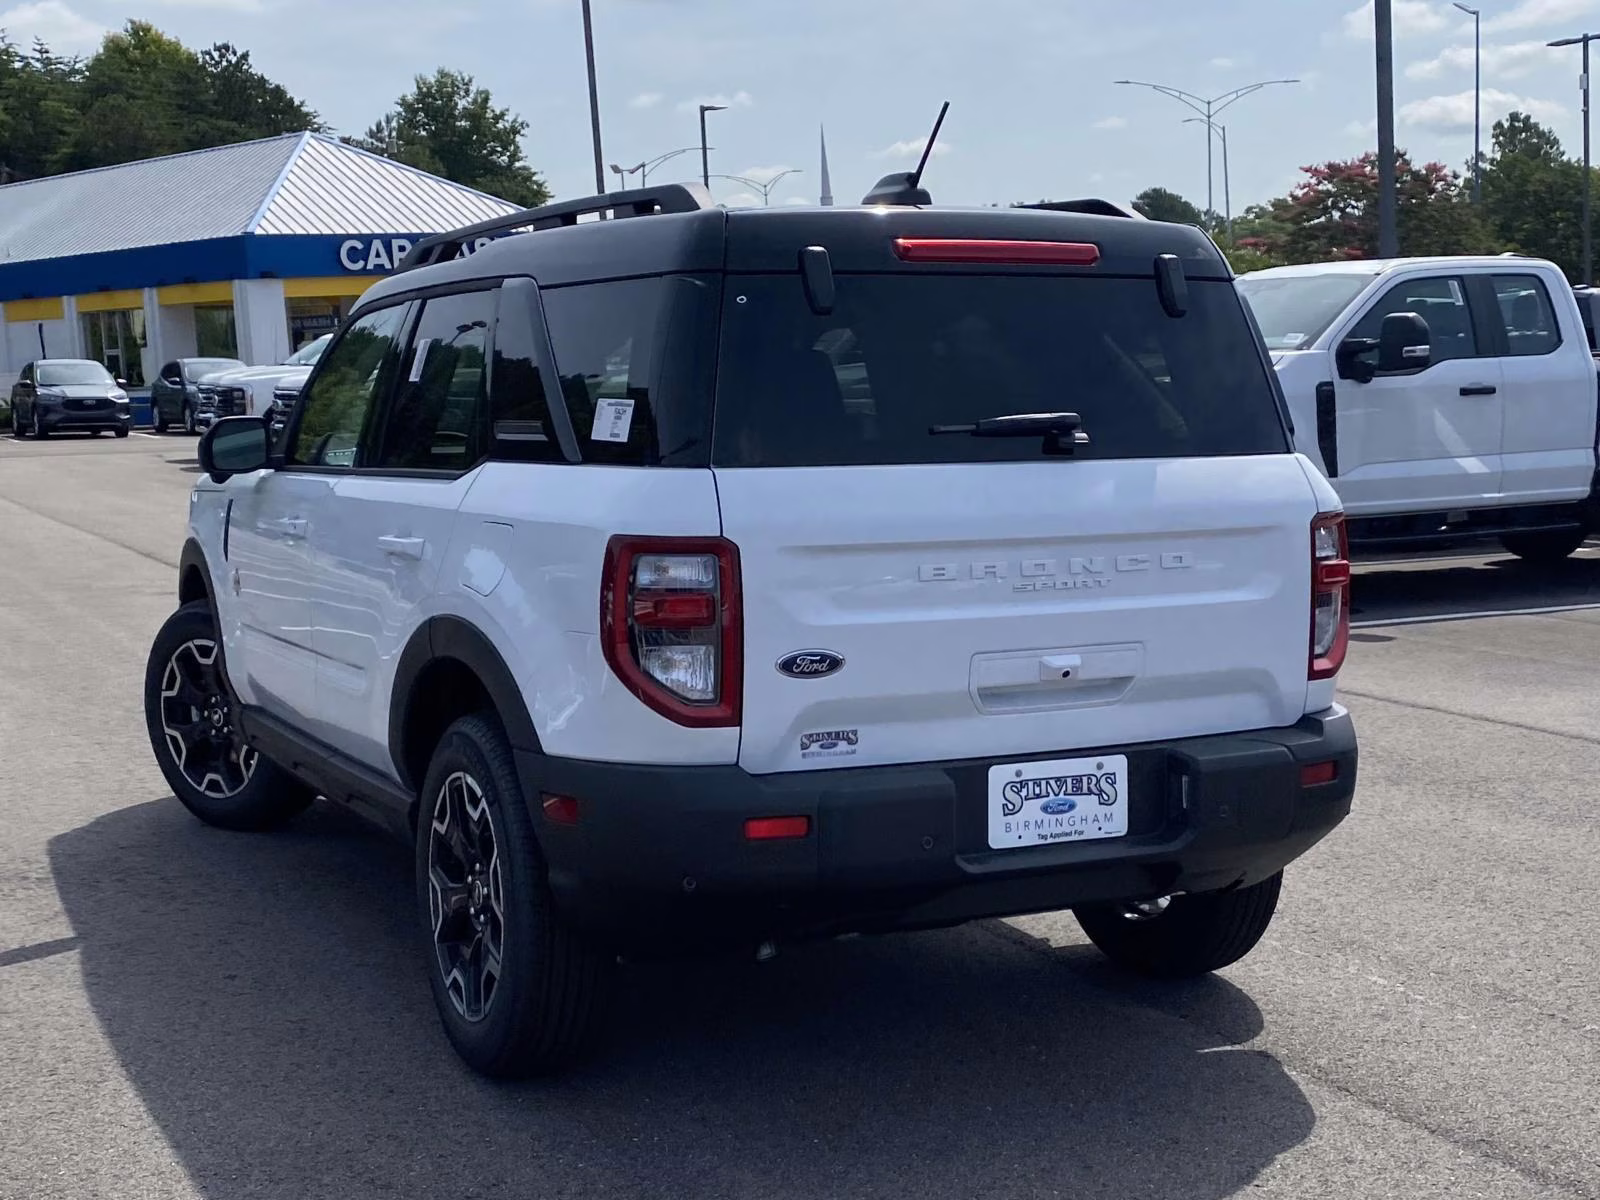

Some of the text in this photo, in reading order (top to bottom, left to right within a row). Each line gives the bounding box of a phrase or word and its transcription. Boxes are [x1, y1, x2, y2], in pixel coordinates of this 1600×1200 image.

[918, 552, 1193, 582] BRONCO
[1012, 577, 1112, 592] SPORT
[1002, 772, 1118, 817] STIVERS
[1004, 812, 1113, 833] BIRMINGHAM
[1037, 833, 1048, 841] Tag
[1049, 831, 1073, 839] Applied
